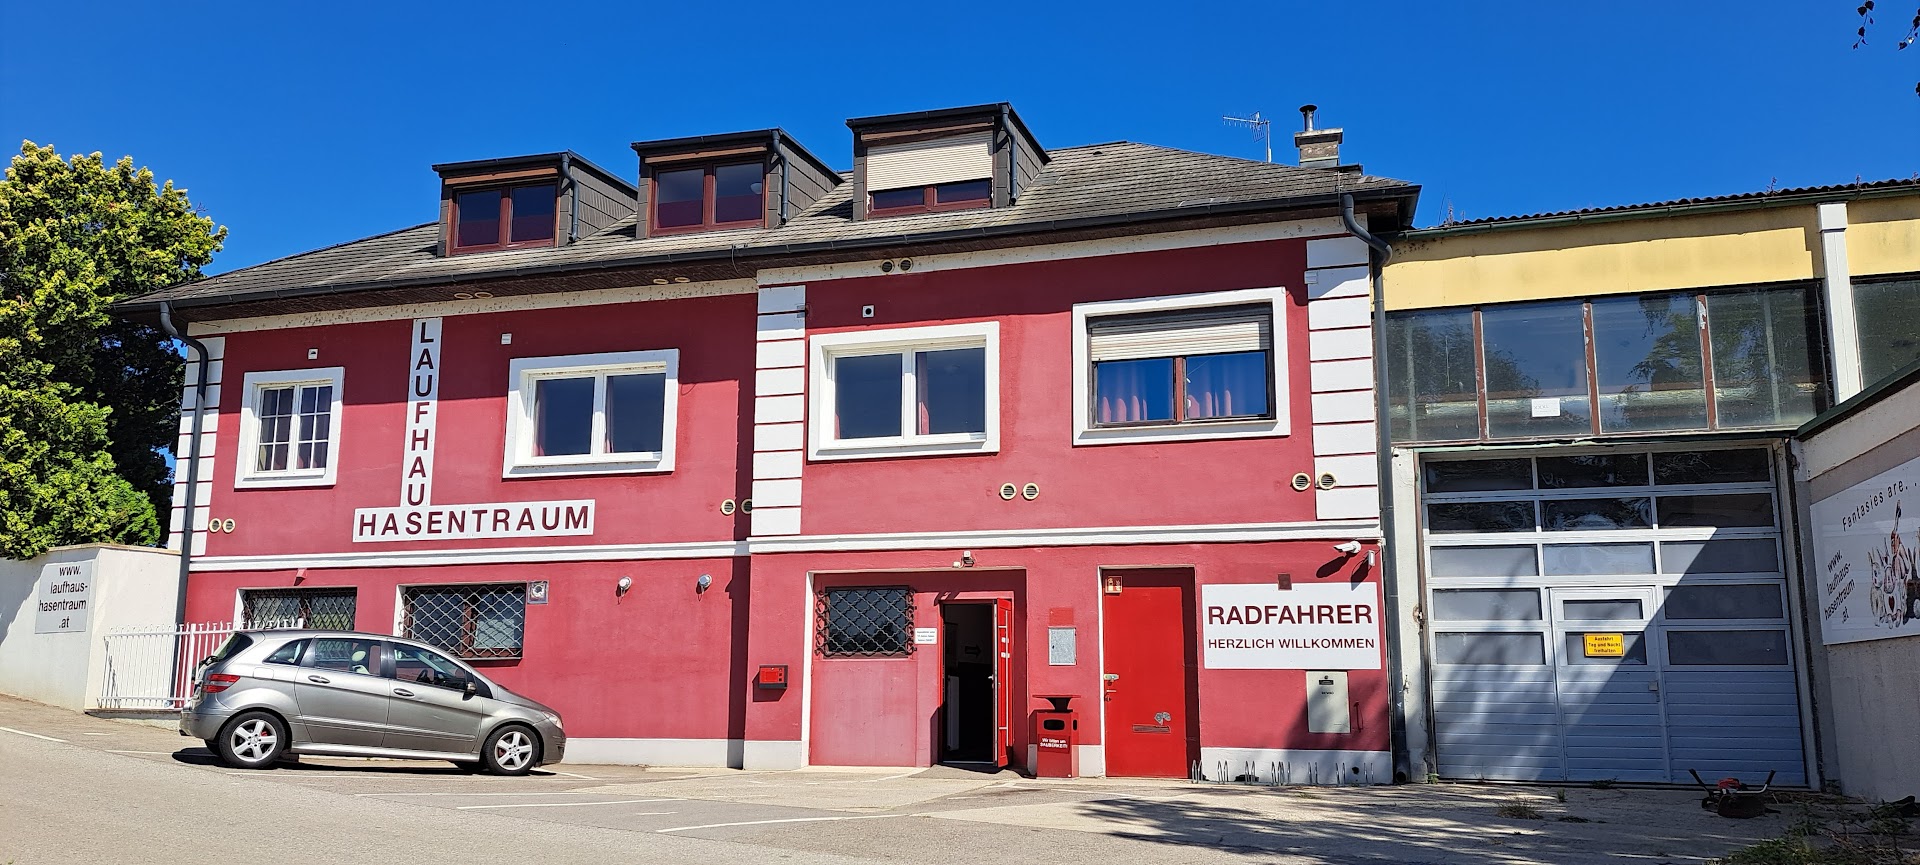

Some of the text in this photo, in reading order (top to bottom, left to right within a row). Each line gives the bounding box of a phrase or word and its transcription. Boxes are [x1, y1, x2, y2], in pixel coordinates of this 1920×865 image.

[358, 506, 589, 535] HASENTRAUM
[1842, 491, 1884, 531] Fantasies
[59, 565, 81, 576] www.
[1827, 550, 1842, 573] www.
[50, 581, 88, 594] laufhaus-
[1826, 562, 1851, 596] laufhaus-
[39, 598, 87, 612] hasentraum
[1824, 579, 1856, 620] hasentraum
[58, 616, 70, 628] .at
[1208, 605, 1372, 624] RADFAHRER
[1208, 638, 1375, 649] HERZLICH WILLKOMMEN
